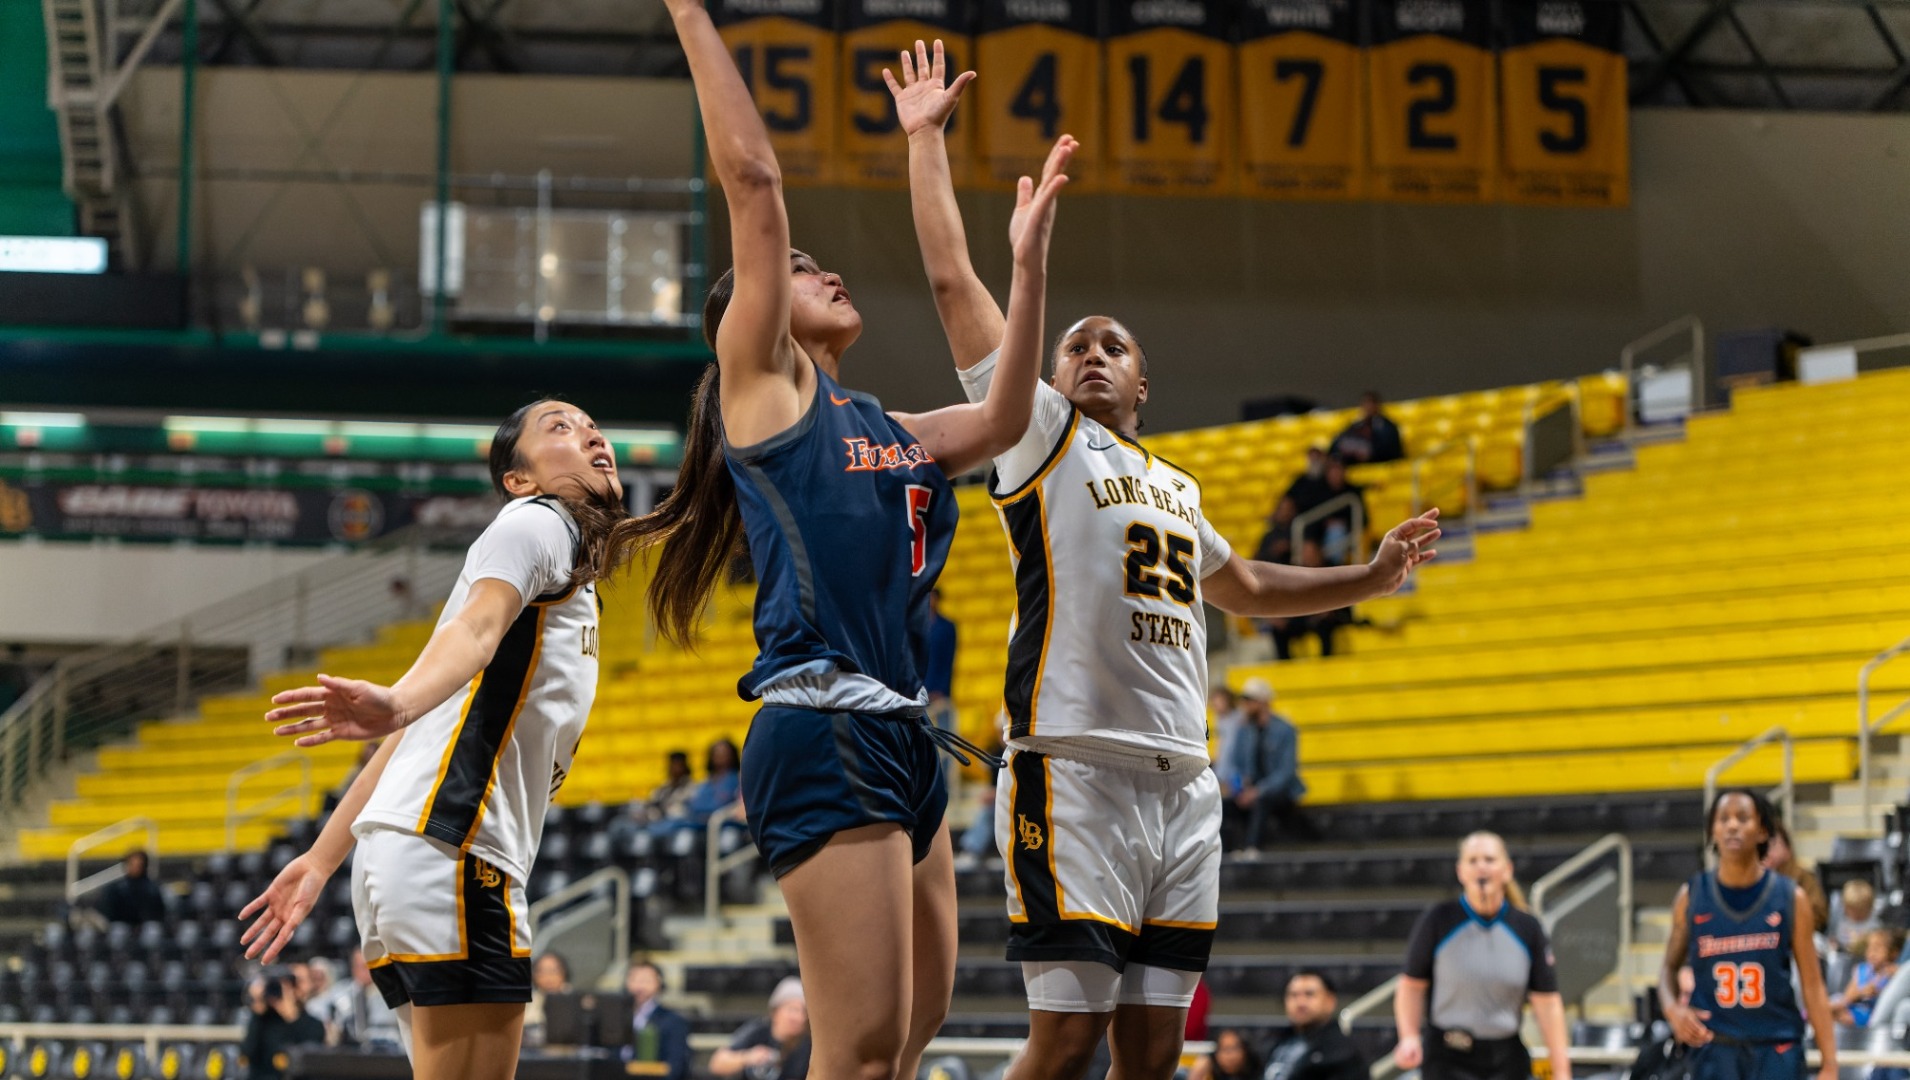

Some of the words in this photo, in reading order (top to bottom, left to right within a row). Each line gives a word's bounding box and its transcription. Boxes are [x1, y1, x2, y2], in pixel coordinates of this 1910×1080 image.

[1010, 53, 1060, 139] 4
[1129, 54, 1209, 143] 14
[1275, 58, 1325, 148] 7
[1407, 63, 1458, 151] 2
[1537, 66, 1588, 153] 5
[905, 484, 932, 577] 5
[1086, 475, 1148, 510] LONG
[1123, 519, 1196, 608] 25
[1131, 611, 1191, 651] STATE
[1712, 961, 1765, 1009] 33
